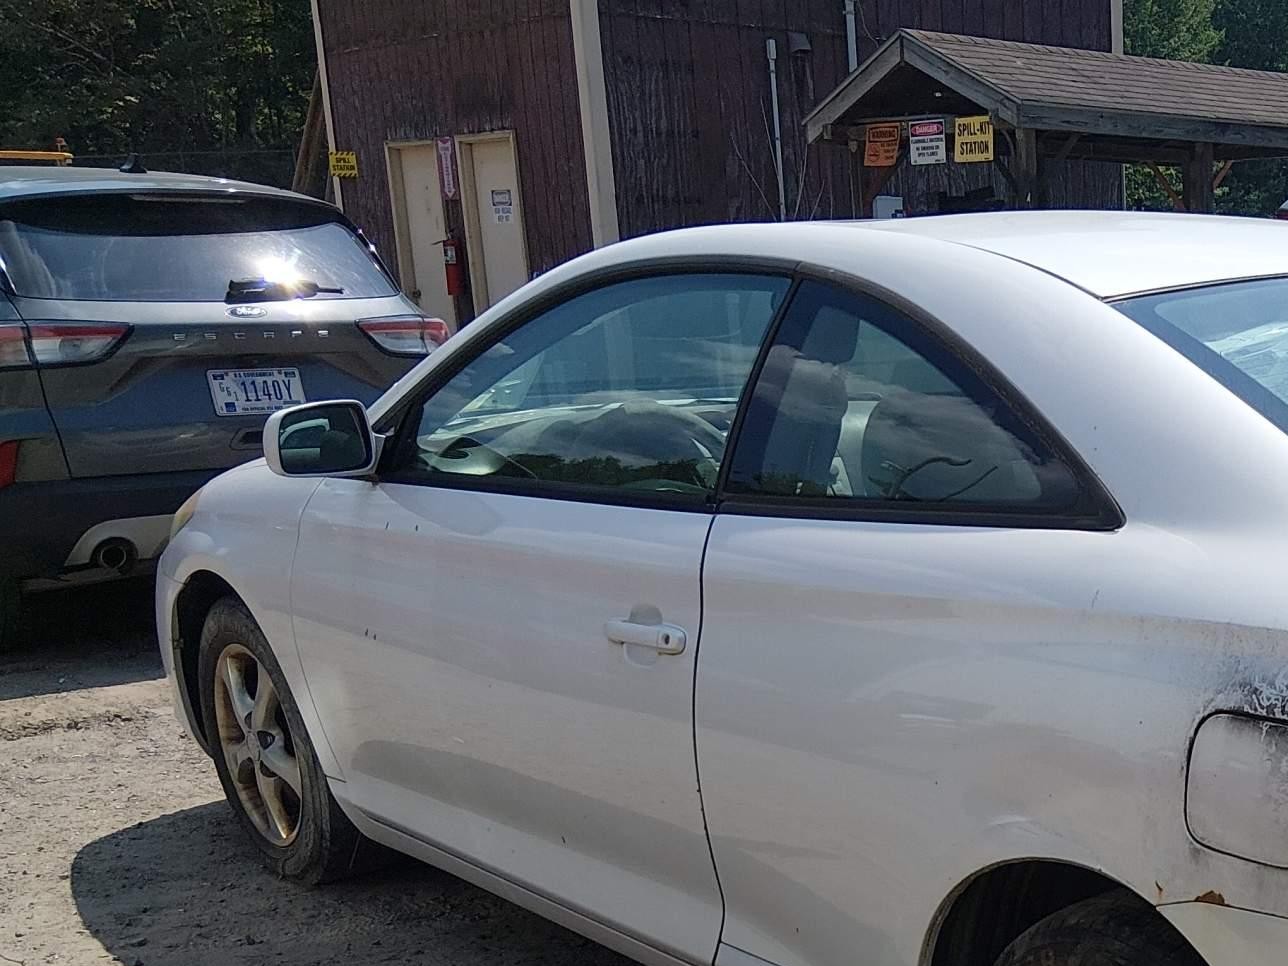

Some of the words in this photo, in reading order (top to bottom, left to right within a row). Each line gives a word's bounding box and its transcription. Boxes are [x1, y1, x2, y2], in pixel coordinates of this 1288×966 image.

[915, 124, 938, 133] DANGER
[958, 121, 990, 136] SPILL-KIT
[960, 141, 990, 155] STATION
[173, 330, 329, 341] ESCAPE
[241, 379, 293, 402] 1140Y
